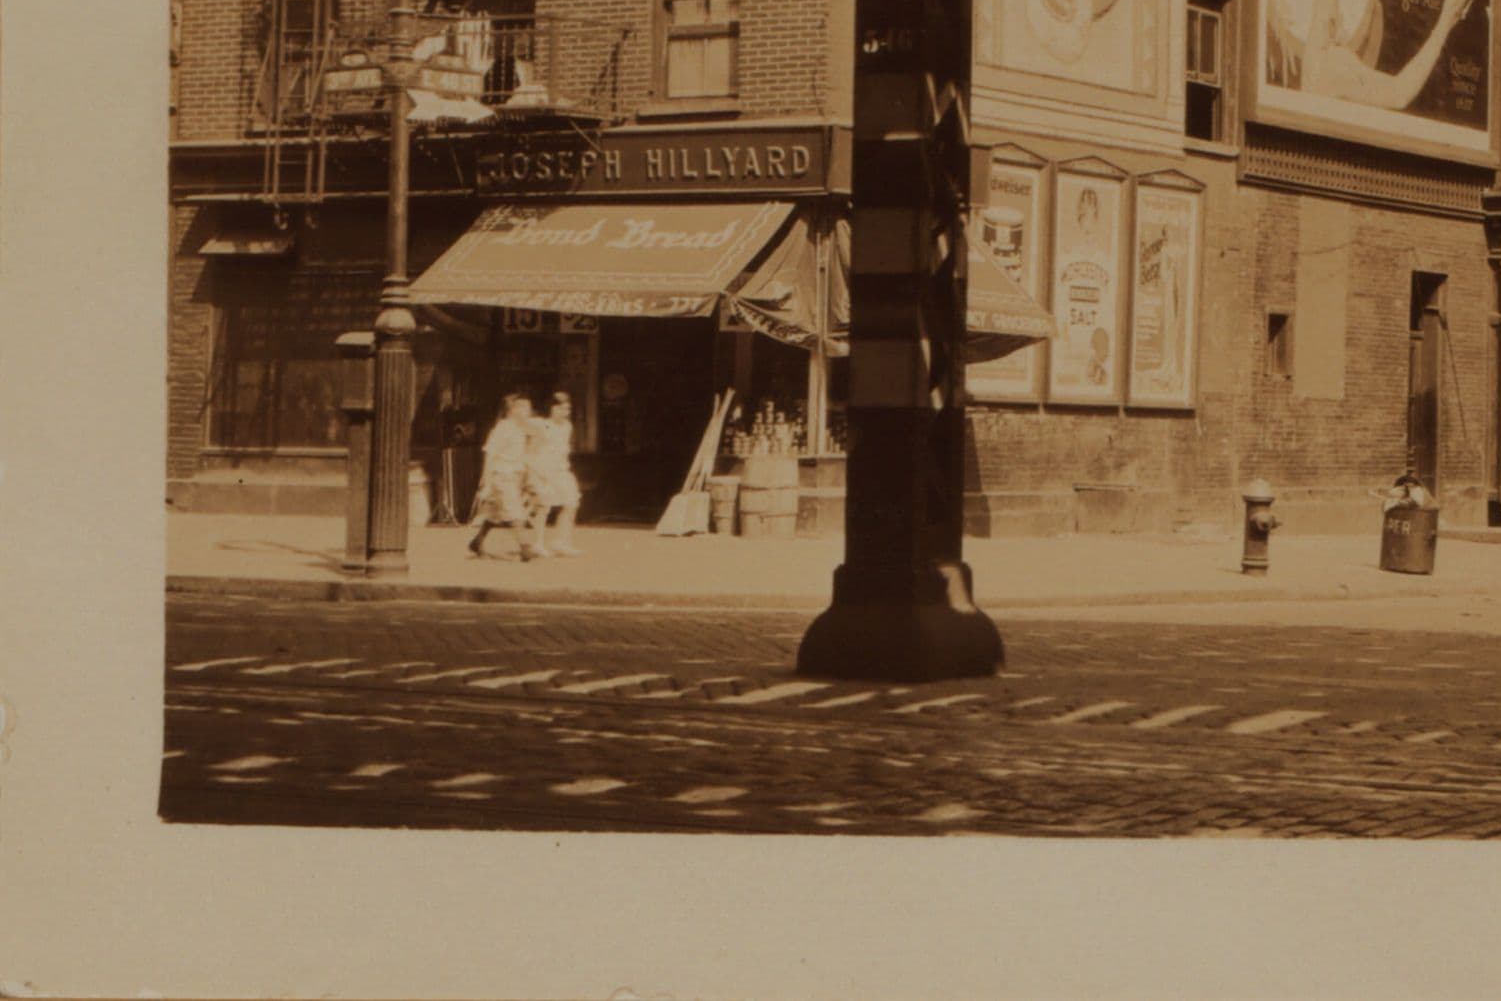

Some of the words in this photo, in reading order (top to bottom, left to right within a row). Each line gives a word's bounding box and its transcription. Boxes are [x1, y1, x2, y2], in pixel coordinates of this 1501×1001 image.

[489, 148, 622, 181] JOSEPH
[647, 145, 811, 179] HILLYARD
[604, 216, 742, 249] Bread
[1070, 307, 1097, 326] SALT
